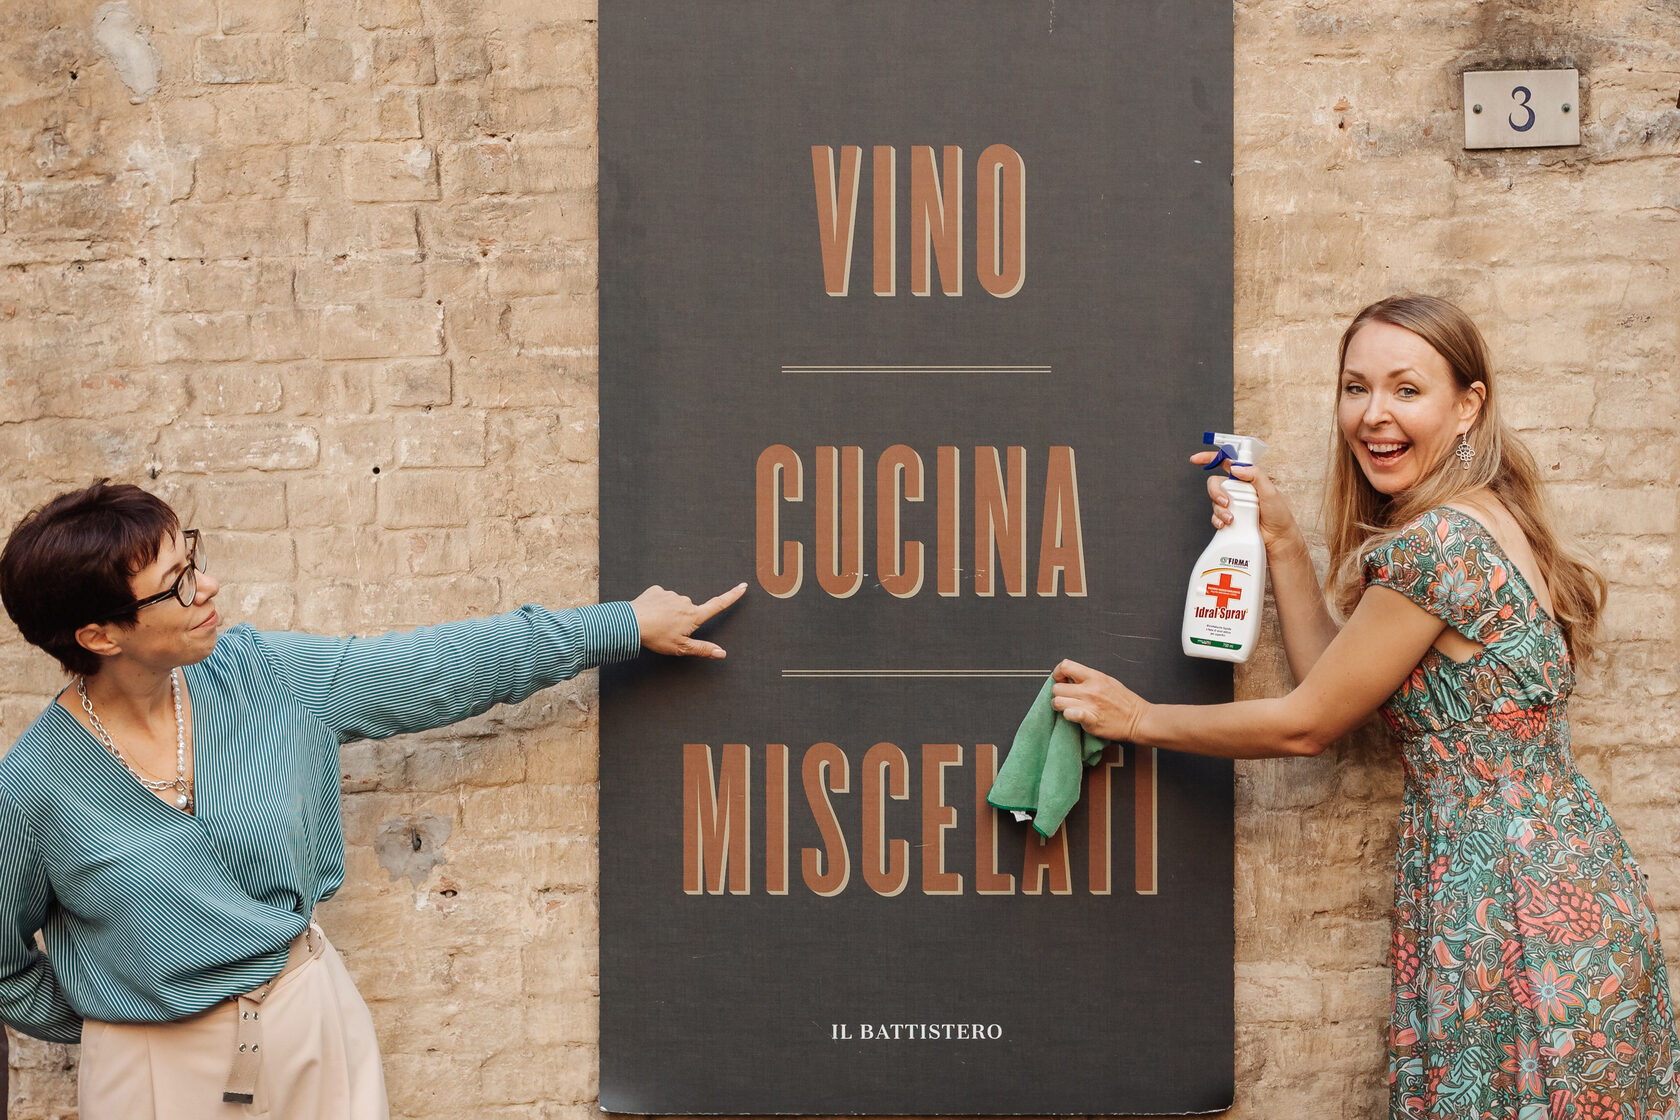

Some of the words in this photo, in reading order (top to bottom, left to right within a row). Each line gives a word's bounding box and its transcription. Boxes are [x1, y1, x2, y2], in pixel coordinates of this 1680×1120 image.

[1508, 86, 1536, 132] 3
[811, 143, 1026, 298] VINO
[755, 443, 1088, 599] CUCINA
[1228, 557, 1249, 567] FIRMA
[831, 1023, 853, 1040] IL
[860, 1023, 1003, 1040] BATTISTERO
